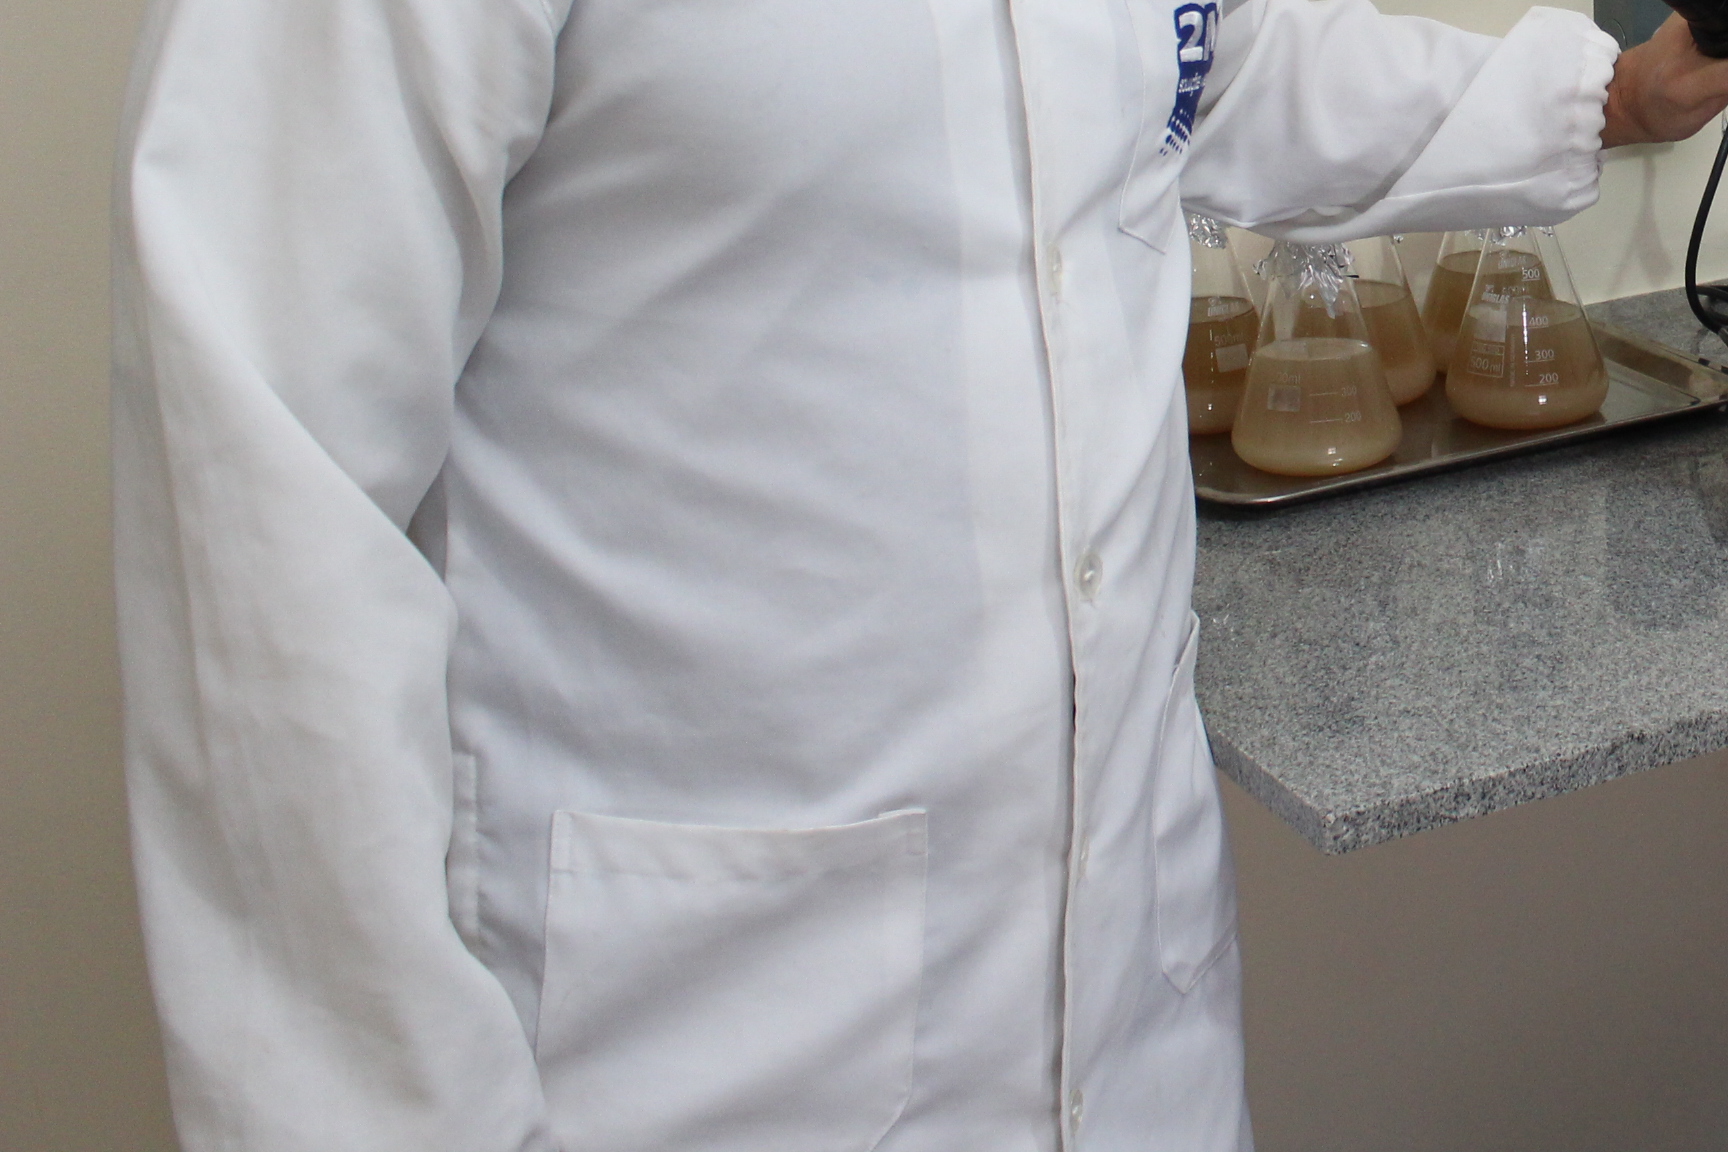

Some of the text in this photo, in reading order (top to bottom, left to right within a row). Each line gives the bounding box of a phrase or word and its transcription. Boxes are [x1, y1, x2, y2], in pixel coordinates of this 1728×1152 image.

[1522, 268, 1540, 279] 500
[1535, 349, 1554, 360] 300
[1539, 373, 1559, 384] 200
